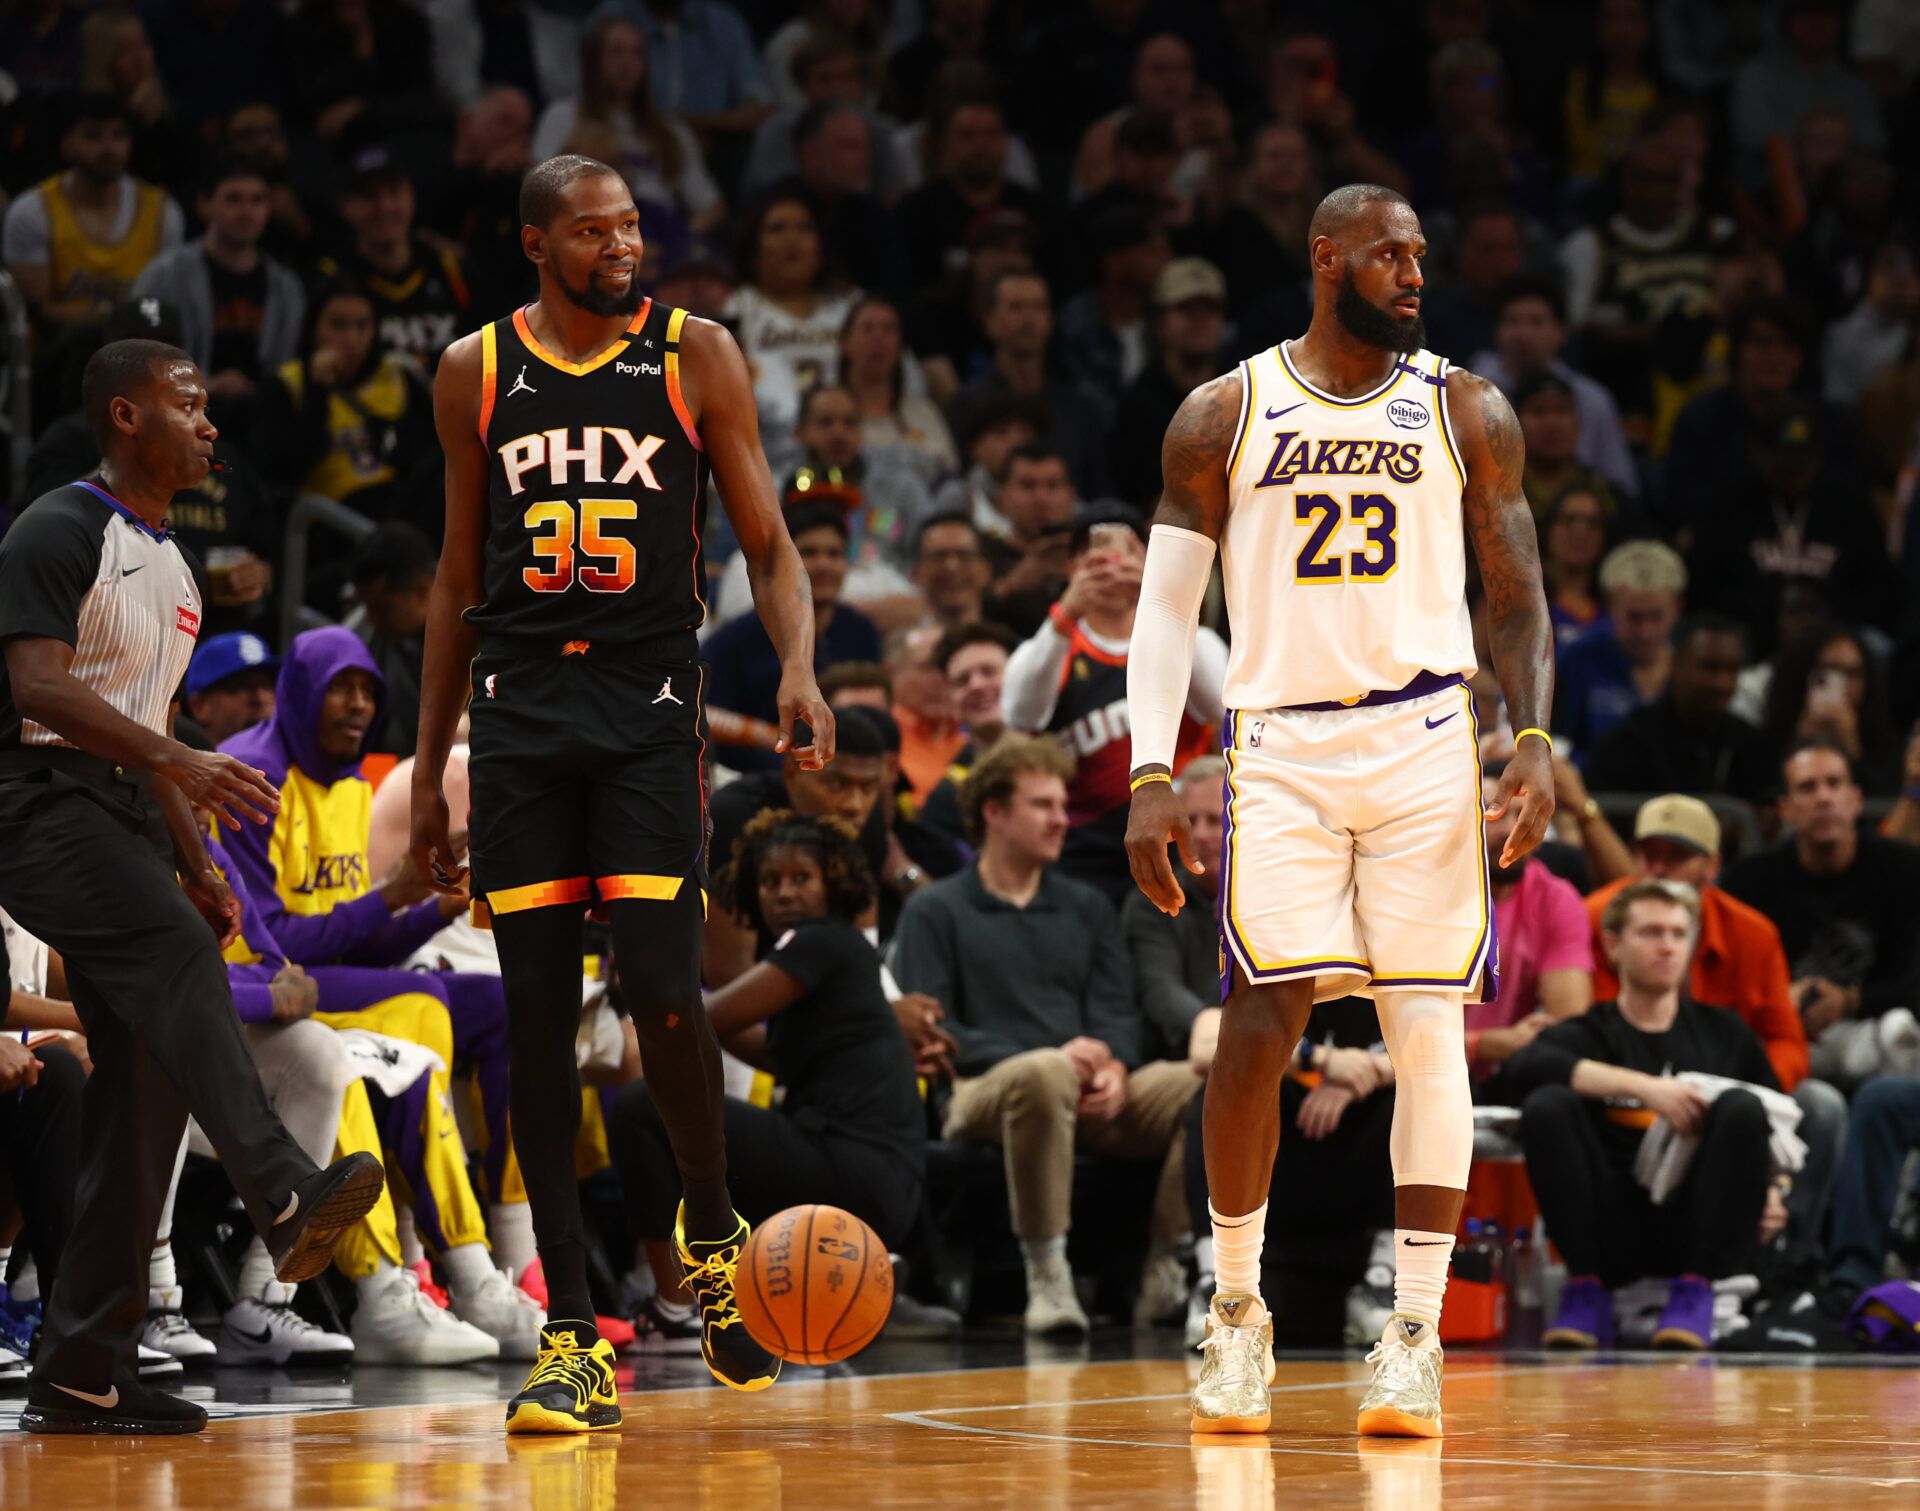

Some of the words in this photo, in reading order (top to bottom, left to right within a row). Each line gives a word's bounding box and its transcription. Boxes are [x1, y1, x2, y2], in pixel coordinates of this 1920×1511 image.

[644, 338, 654, 349] AL
[615, 361, 662, 377] PayPal
[1390, 405, 1428, 422] bibigo
[497, 426, 666, 496] PHX
[522, 498, 638, 593] 35
[1293, 491, 1399, 586] 23
